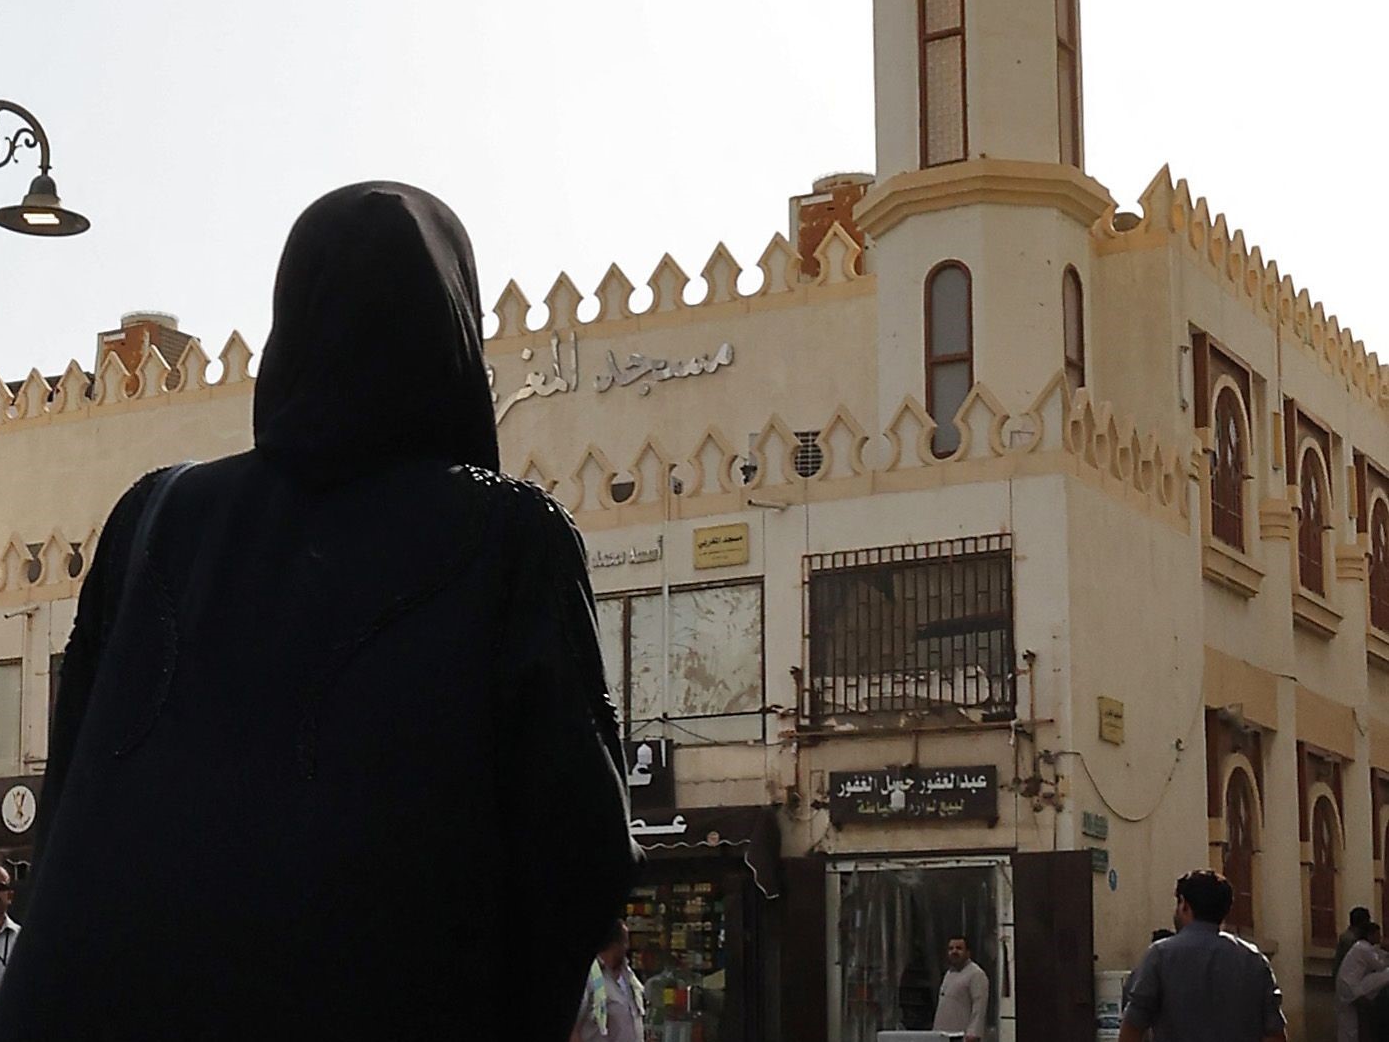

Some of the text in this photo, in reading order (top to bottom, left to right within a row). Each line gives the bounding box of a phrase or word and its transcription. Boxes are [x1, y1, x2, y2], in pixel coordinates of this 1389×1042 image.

[486, 330, 734, 426] مسجد المغر
[837, 775, 877, 797] الغفور
